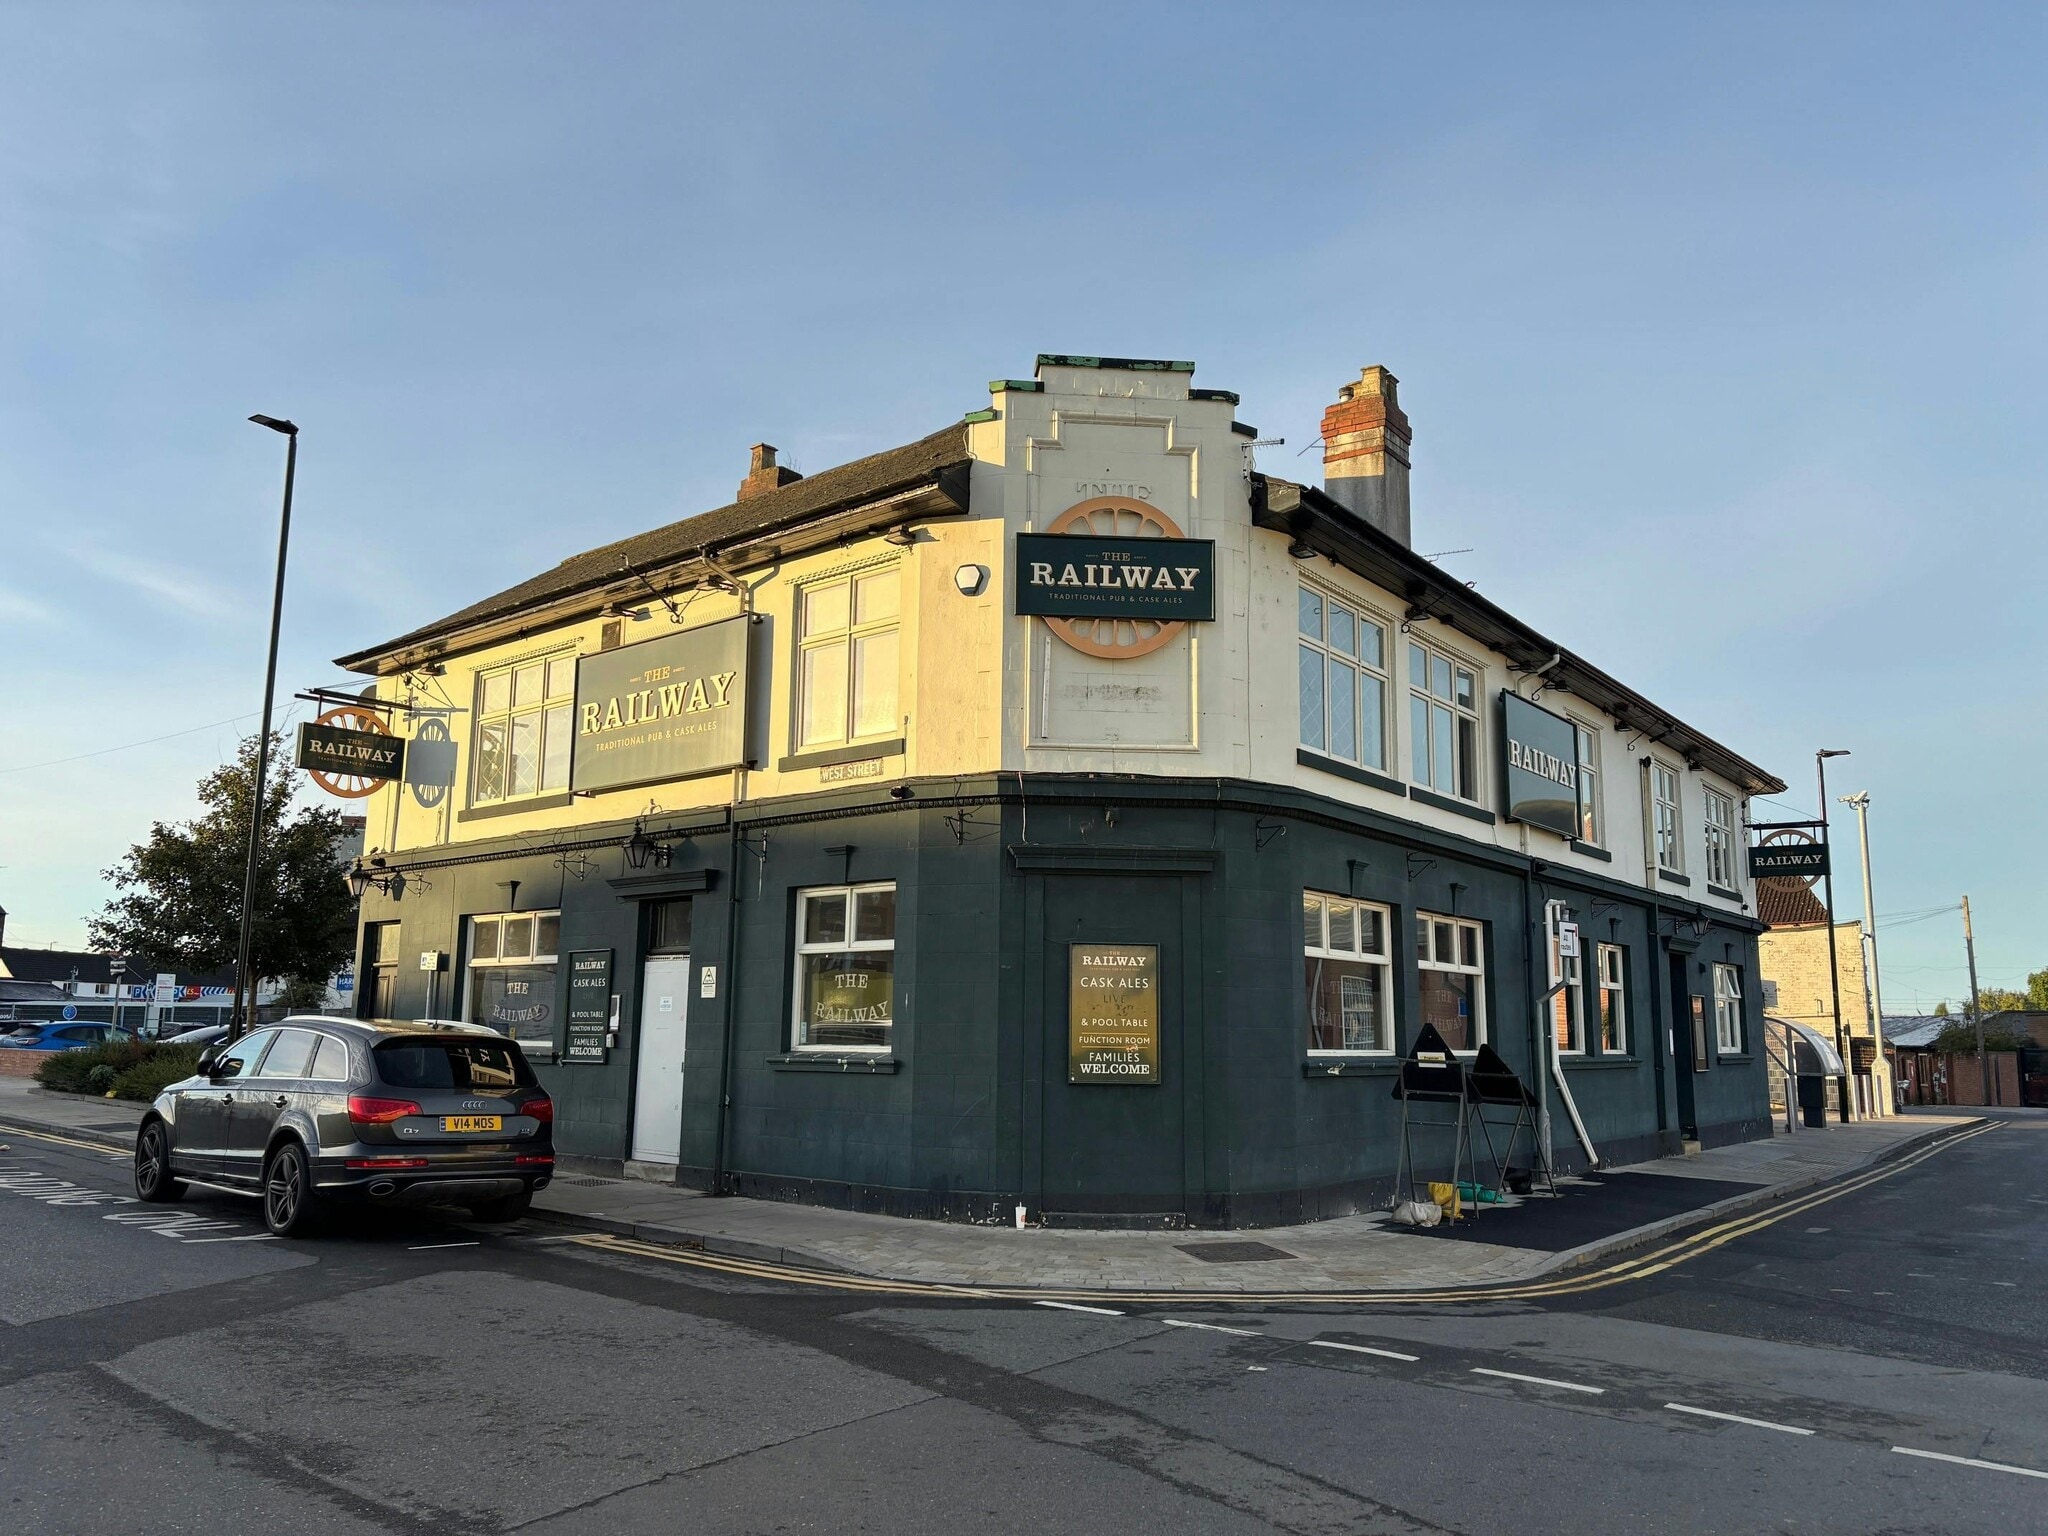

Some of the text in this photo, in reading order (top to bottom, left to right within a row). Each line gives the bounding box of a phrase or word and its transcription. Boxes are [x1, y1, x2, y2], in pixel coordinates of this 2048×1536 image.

[1102, 552, 1130, 562] THE
[1030, 562, 1200, 591] RAILWAY
[1049, 593, 1105, 602] TRADITIONAL
[644, 666, 671, 684] THE
[580, 671, 737, 736] RAILWAY
[596, 721, 718, 752] TRADITIONAL PUB & CASK ALES
[309, 739, 396, 764] RAILWAY
[821, 760, 882, 780] WEST STREET
[1508, 739, 1577, 789] RAILWAY
[1754, 854, 1823, 866] RAILWAY
[575, 960, 606, 971] RAILWAY
[1082, 955, 1146, 967] RAILWAY
[573, 977, 606, 988] CASK ALES
[835, 973, 869, 989] THE
[1080, 977, 1149, 989] CASK ALES
[507, 982, 529, 995] THE
[493, 1004, 541, 1022] RAILWAY
[814, 1000, 889, 1023] RAILWAY
[1081, 1018, 1148, 1027] & POOL TABLE
[573, 1038, 599, 1046] FAMILIES
[1078, 1036, 1150, 1045] FUNCTION ROOM
[569, 1046, 603, 1056] WELCOME
[1089, 1052, 1140, 1063] FAMILIES
[1079, 1063, 1150, 1075] WELCOME
[453, 1117, 495, 1129] V14 MOS
[403, 1126, 420, 1134] Q7
[102, 1211, 284, 1243] ONLY
